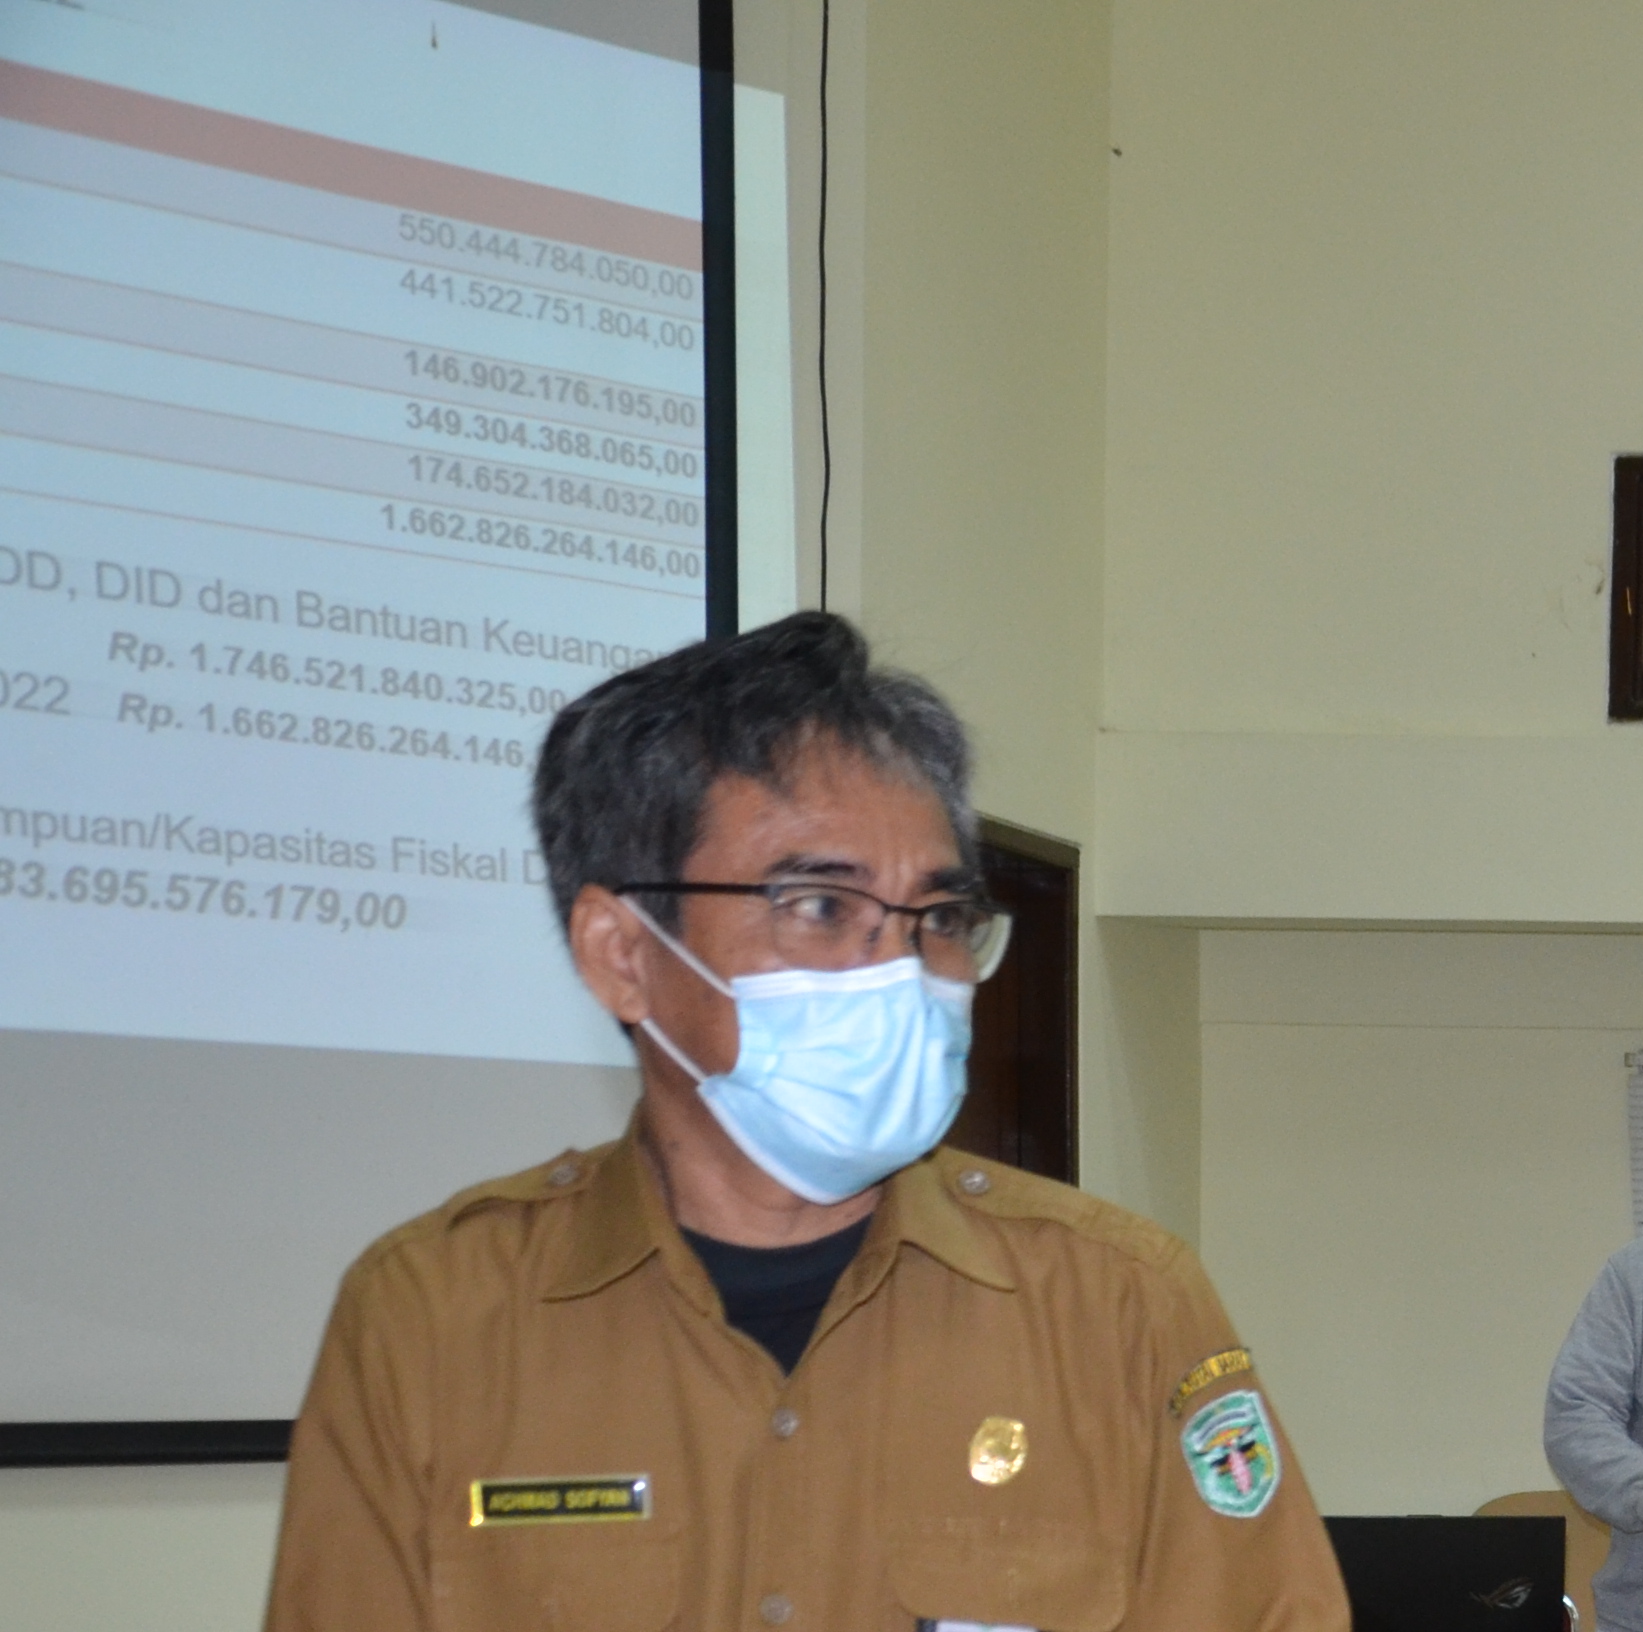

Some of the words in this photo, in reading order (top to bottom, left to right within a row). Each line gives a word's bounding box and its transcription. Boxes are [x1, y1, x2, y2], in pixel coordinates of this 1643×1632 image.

[398, 212, 695, 303] 550.444.784.050,00
[399, 267, 696, 354] 441.522.751.804,00
[403, 349, 697, 431] 146.902.176.195,00
[405, 402, 698, 482] 349.304.368.065,00
[406, 454, 700, 531] 174.652.184.032,00
[380, 503, 701, 581] 1.662.826.264.146,00
[95, 560, 182, 609] DID
[197, 578, 280, 624] dan
[295, 589, 468, 649] Bantuan
[107, 630, 175, 673] Rp.
[117, 692, 184, 734] Rp.
[390, 835, 508, 883] Fiskal
